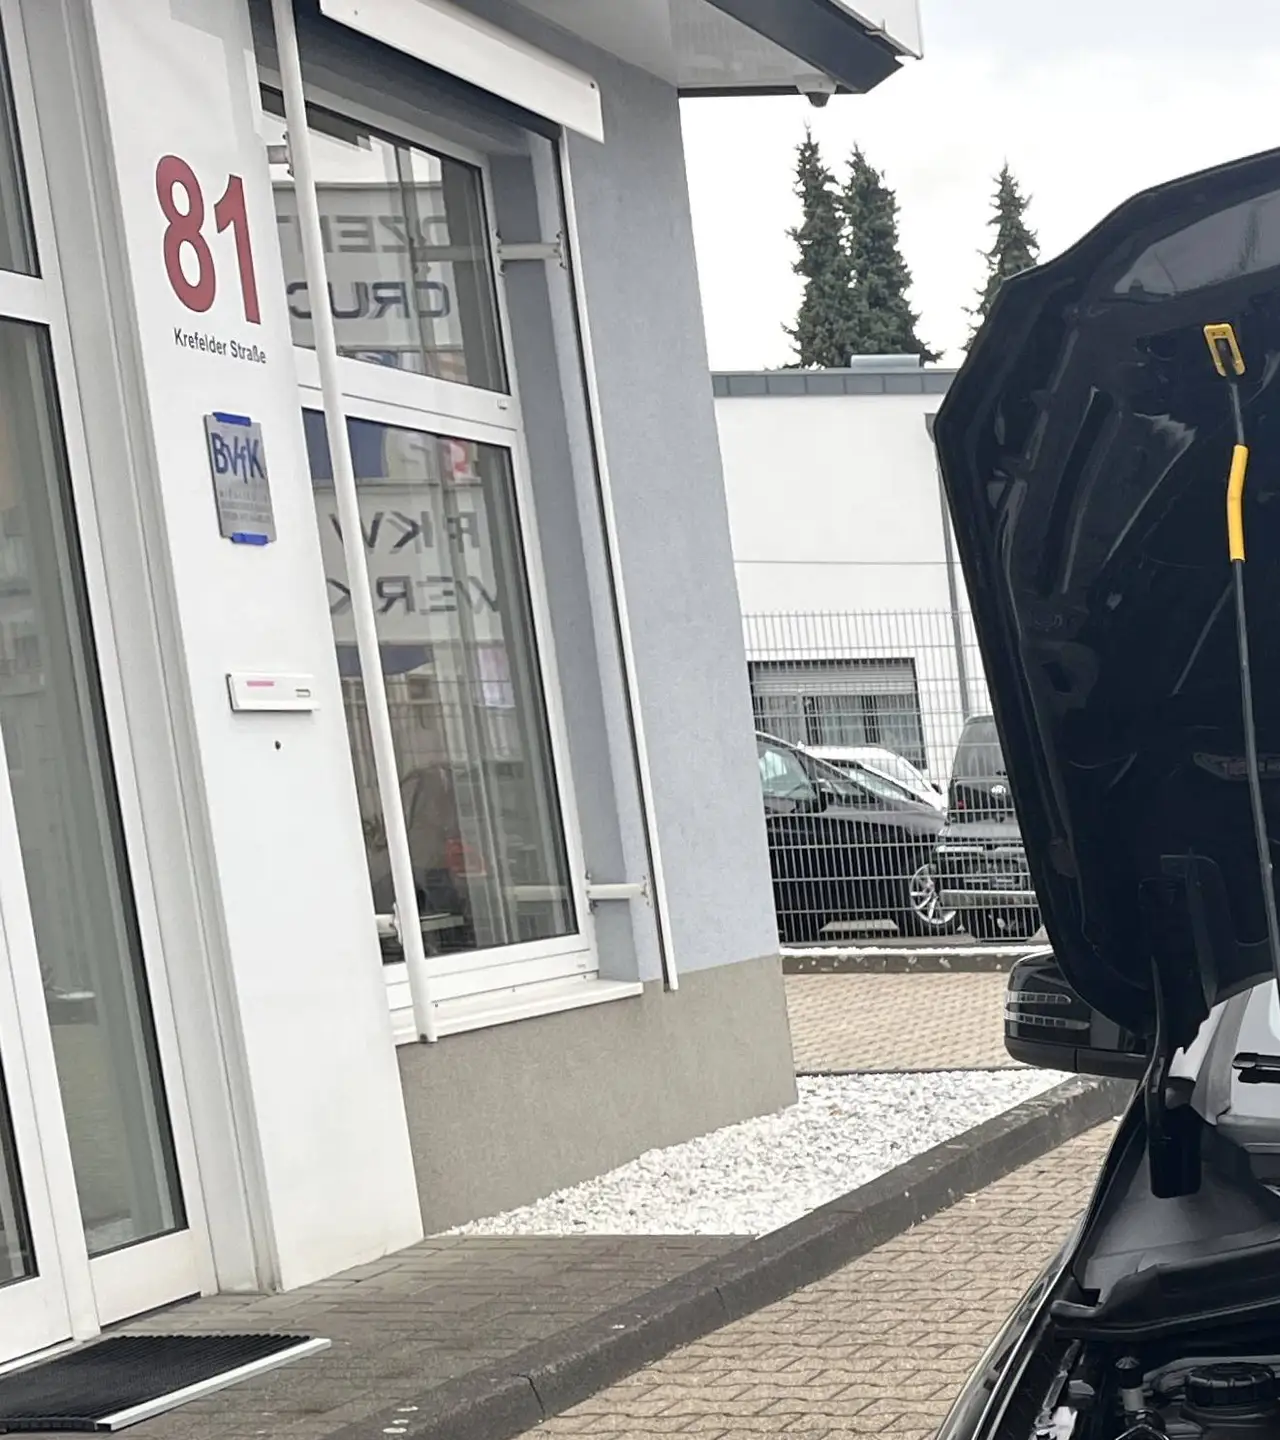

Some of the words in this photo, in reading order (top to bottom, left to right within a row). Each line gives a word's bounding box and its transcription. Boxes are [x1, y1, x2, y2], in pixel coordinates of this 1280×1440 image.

[155, 154, 261, 325] 81
[173, 327, 227, 356] Krefelder
[230, 340, 266, 364] Straße
